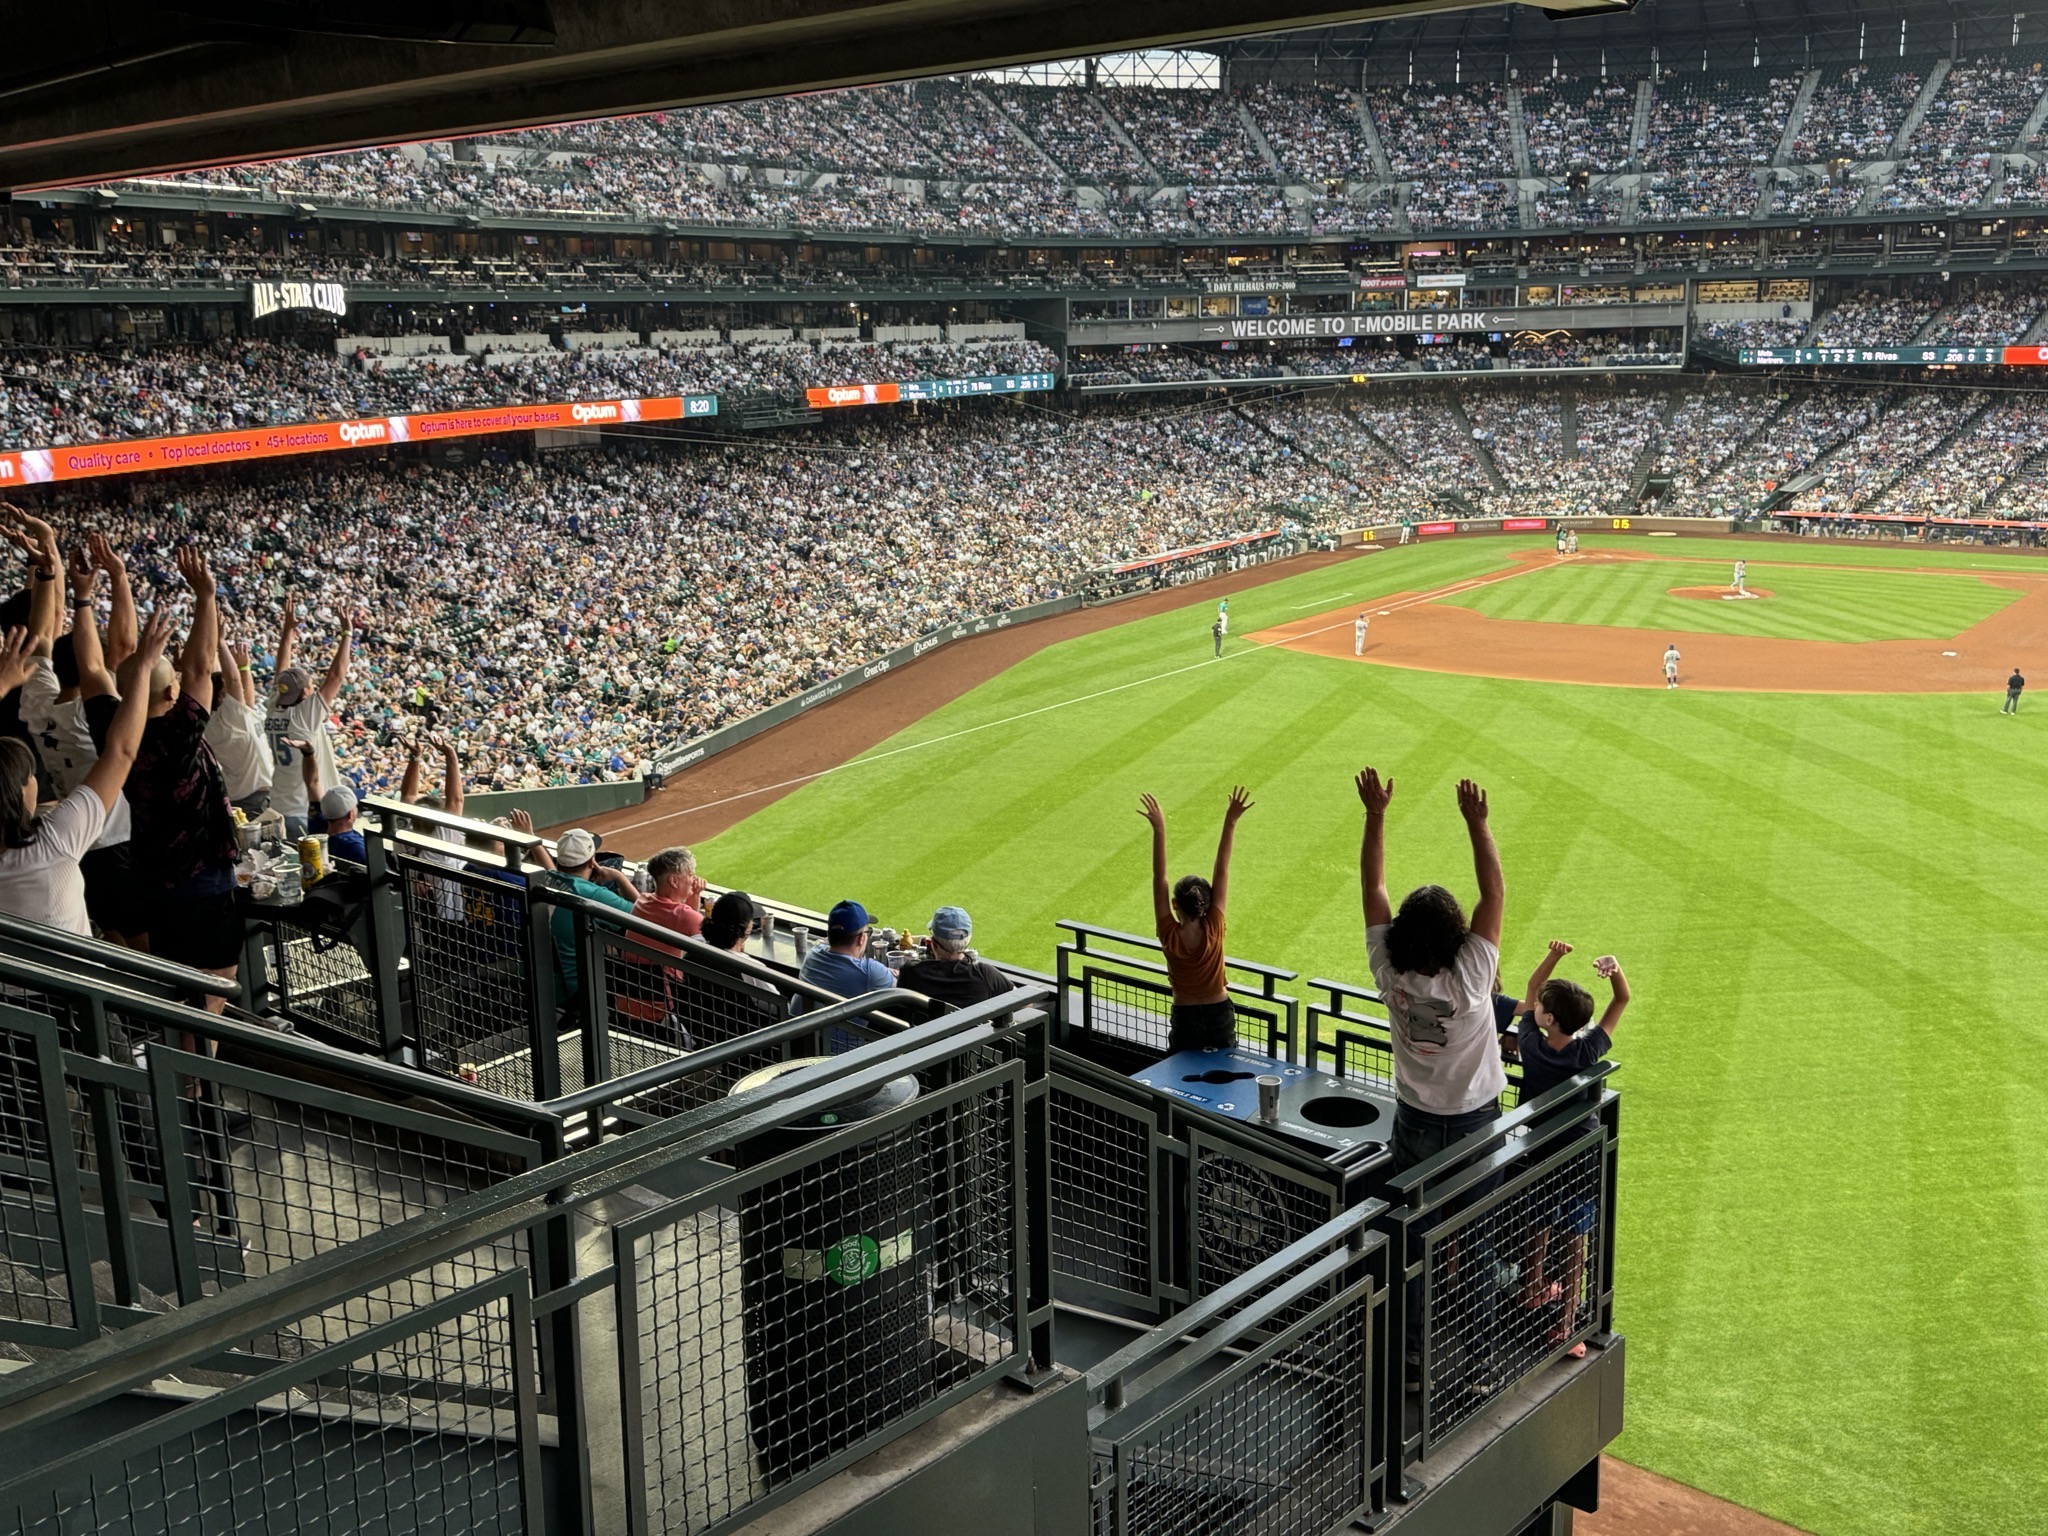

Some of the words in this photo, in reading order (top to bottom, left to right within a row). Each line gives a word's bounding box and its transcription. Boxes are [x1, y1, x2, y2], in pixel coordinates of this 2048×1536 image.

[1213, 282, 1232, 292] DAVE
[1233, 281, 1265, 292] NIEHAUS
[1265, 281, 1296, 290] 1977-2010
[1360, 279, 1381, 288] ROOT
[1381, 279, 1405, 287] SPORTS
[280, 282, 313, 309] STAR
[313, 282, 346, 316] CLUB
[1231, 318, 1316, 337] WELCOME
[1321, 317, 1345, 334] TO
[1351, 314, 1433, 333] T-MOBILE
[1437, 312, 1487, 330] PARK
[1834, 354, 1841, 362] 2
[1847, 354, 1854, 362] 2
[1922, 352, 1936, 361] SS
[1968, 353, 1975, 362] 0
[1986, 353, 1993, 362] 3
[828, 388, 861, 405] Optum
[955, 385, 960, 394] 2
[963, 384, 968, 393] 2
[572, 404, 617, 424] Optum
[690, 399, 709, 413] 8:20
[420, 420, 448, 436] Optum
[448, 418, 455, 430] is
[456, 417, 472, 430] here
[473, 416, 482, 428] to
[482, 415, 502, 427] cover
[503, 413, 511, 425] all
[511, 412, 533, 427] your
[534, 411, 560, 422] bases
[339, 421, 385, 446] Optum
[68, 451, 113, 470] Quality
[115, 452, 141, 465] care
[160, 446, 183, 462] Top
[184, 443, 209, 458] local
[211, 439, 251, 455] doctors
[266, 435, 285, 448] 45+
[286, 431, 329, 447] locations
[920, 636, 939, 651] LEXUS
[863, 665, 878, 678] Great
[1161, 1085, 1189, 1098] RECYCLE
[1189, 1093, 1208, 1102] ONLY
[1281, 1121, 1315, 1134] COMPOST
[1313, 1131, 1334, 1139] ONLY
